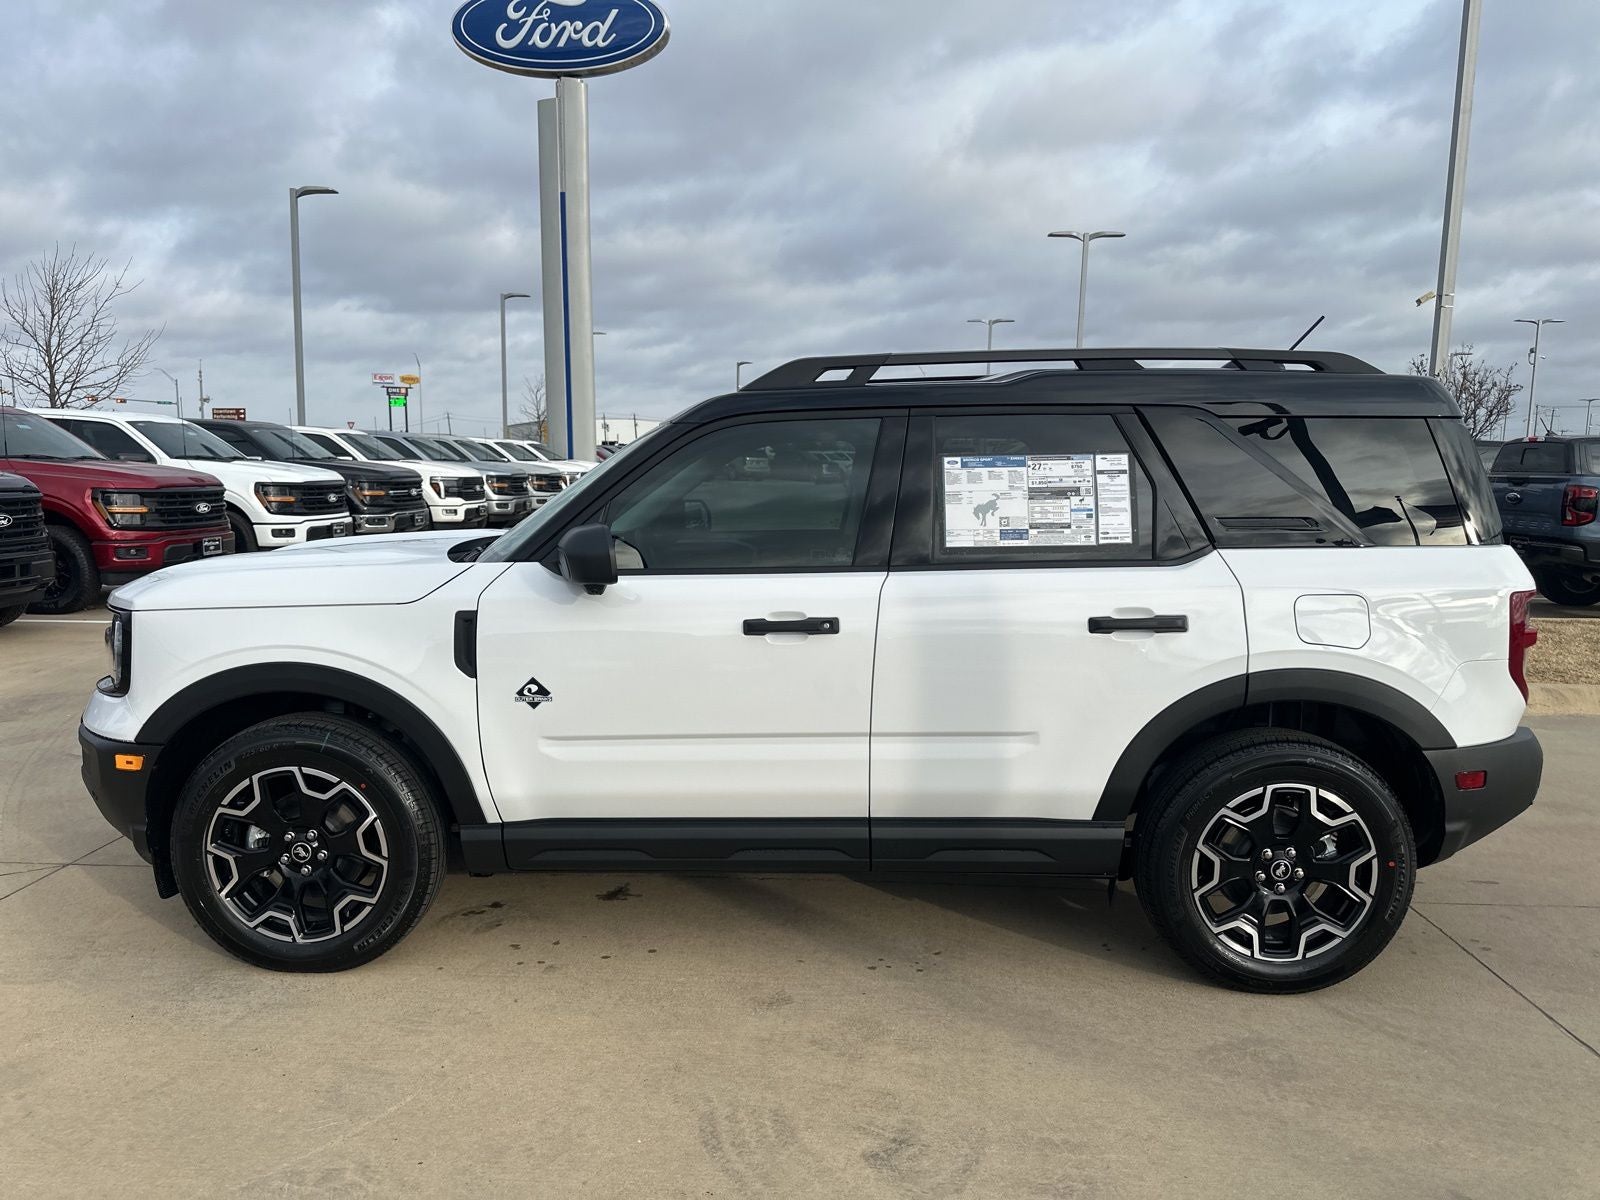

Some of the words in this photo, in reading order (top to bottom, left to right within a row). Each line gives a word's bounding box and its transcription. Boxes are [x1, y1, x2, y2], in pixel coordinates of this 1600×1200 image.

[495, 0, 620, 49] Ford
[373, 373, 393, 382] Exxon
[1031, 463, 1042, 471] 27
